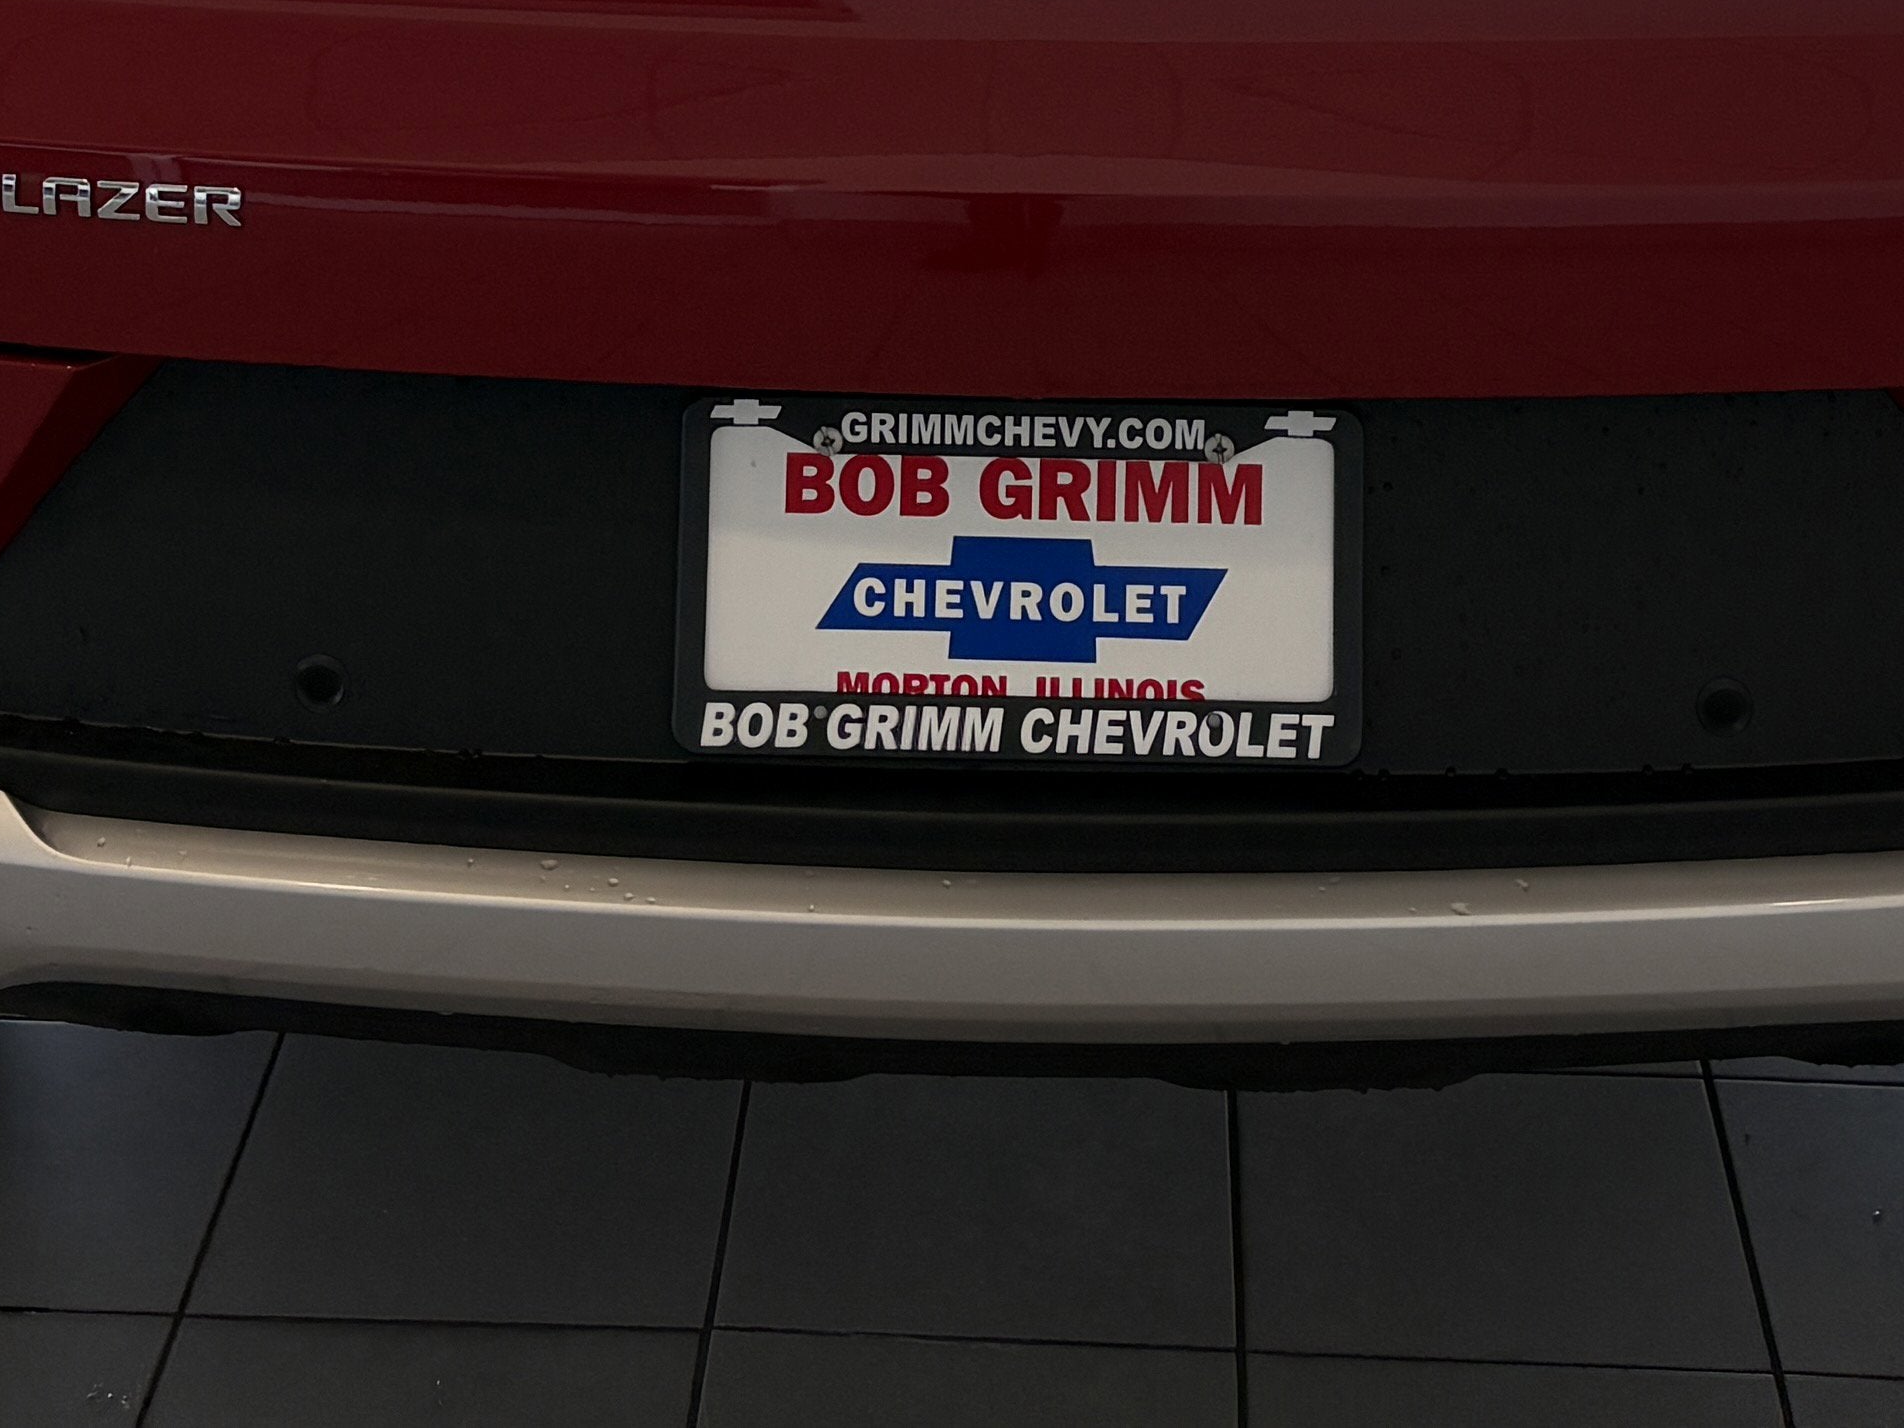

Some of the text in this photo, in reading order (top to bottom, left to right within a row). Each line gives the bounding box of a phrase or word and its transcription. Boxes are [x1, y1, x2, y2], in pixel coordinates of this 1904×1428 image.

[840, 411, 1207, 451] GRIMMCHEVY.COM
[784, 452, 1263, 526] BOB GRIMM
[852, 576, 1188, 625] CHEVROLET
[700, 701, 1335, 759] BOB GRIMM CHEVROLET
